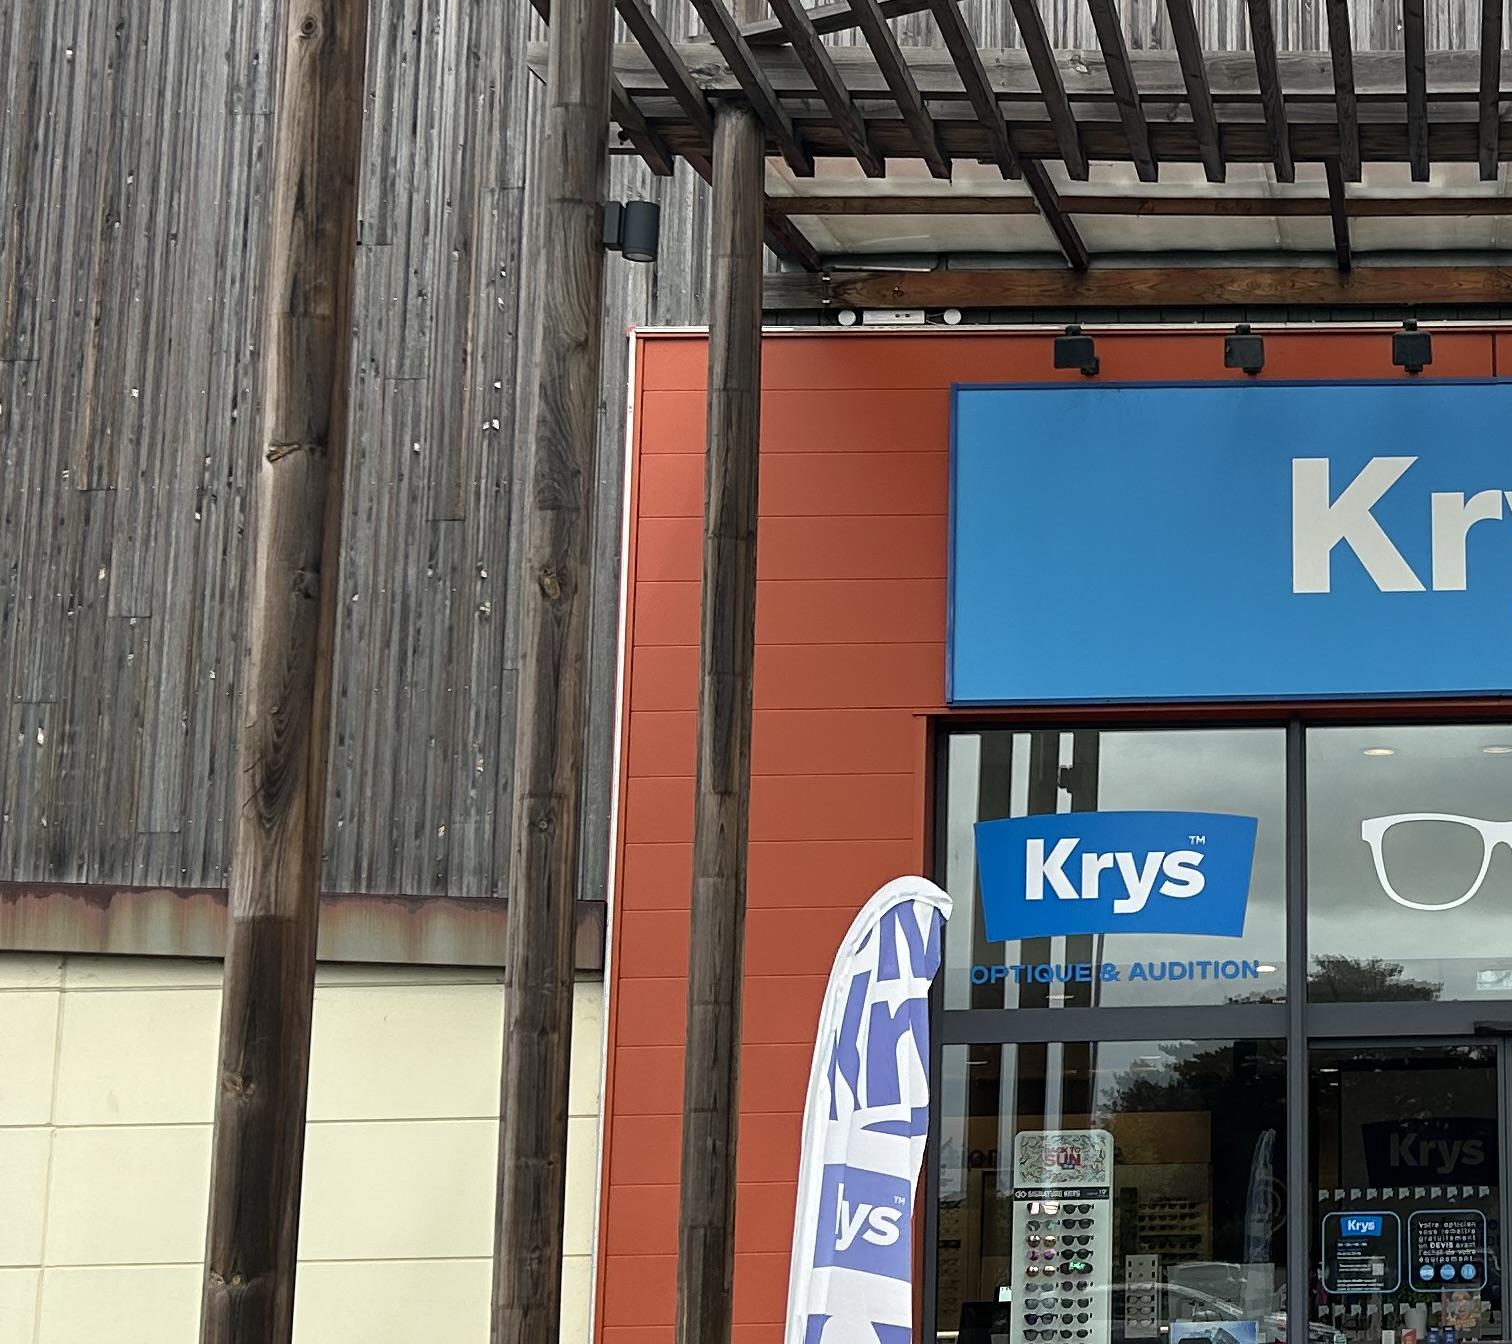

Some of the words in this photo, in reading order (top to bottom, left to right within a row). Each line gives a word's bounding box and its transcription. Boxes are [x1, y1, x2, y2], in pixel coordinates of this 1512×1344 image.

[1025, 837, 1206, 914] Krys
[971, 963, 1092, 985] OPTIQUE
[1100, 962, 1121, 982] &
[1128, 959, 1259, 982] AUDITION
[1390, 1133, 1486, 1174] Krys
[1347, 1219, 1376, 1233] Krys
